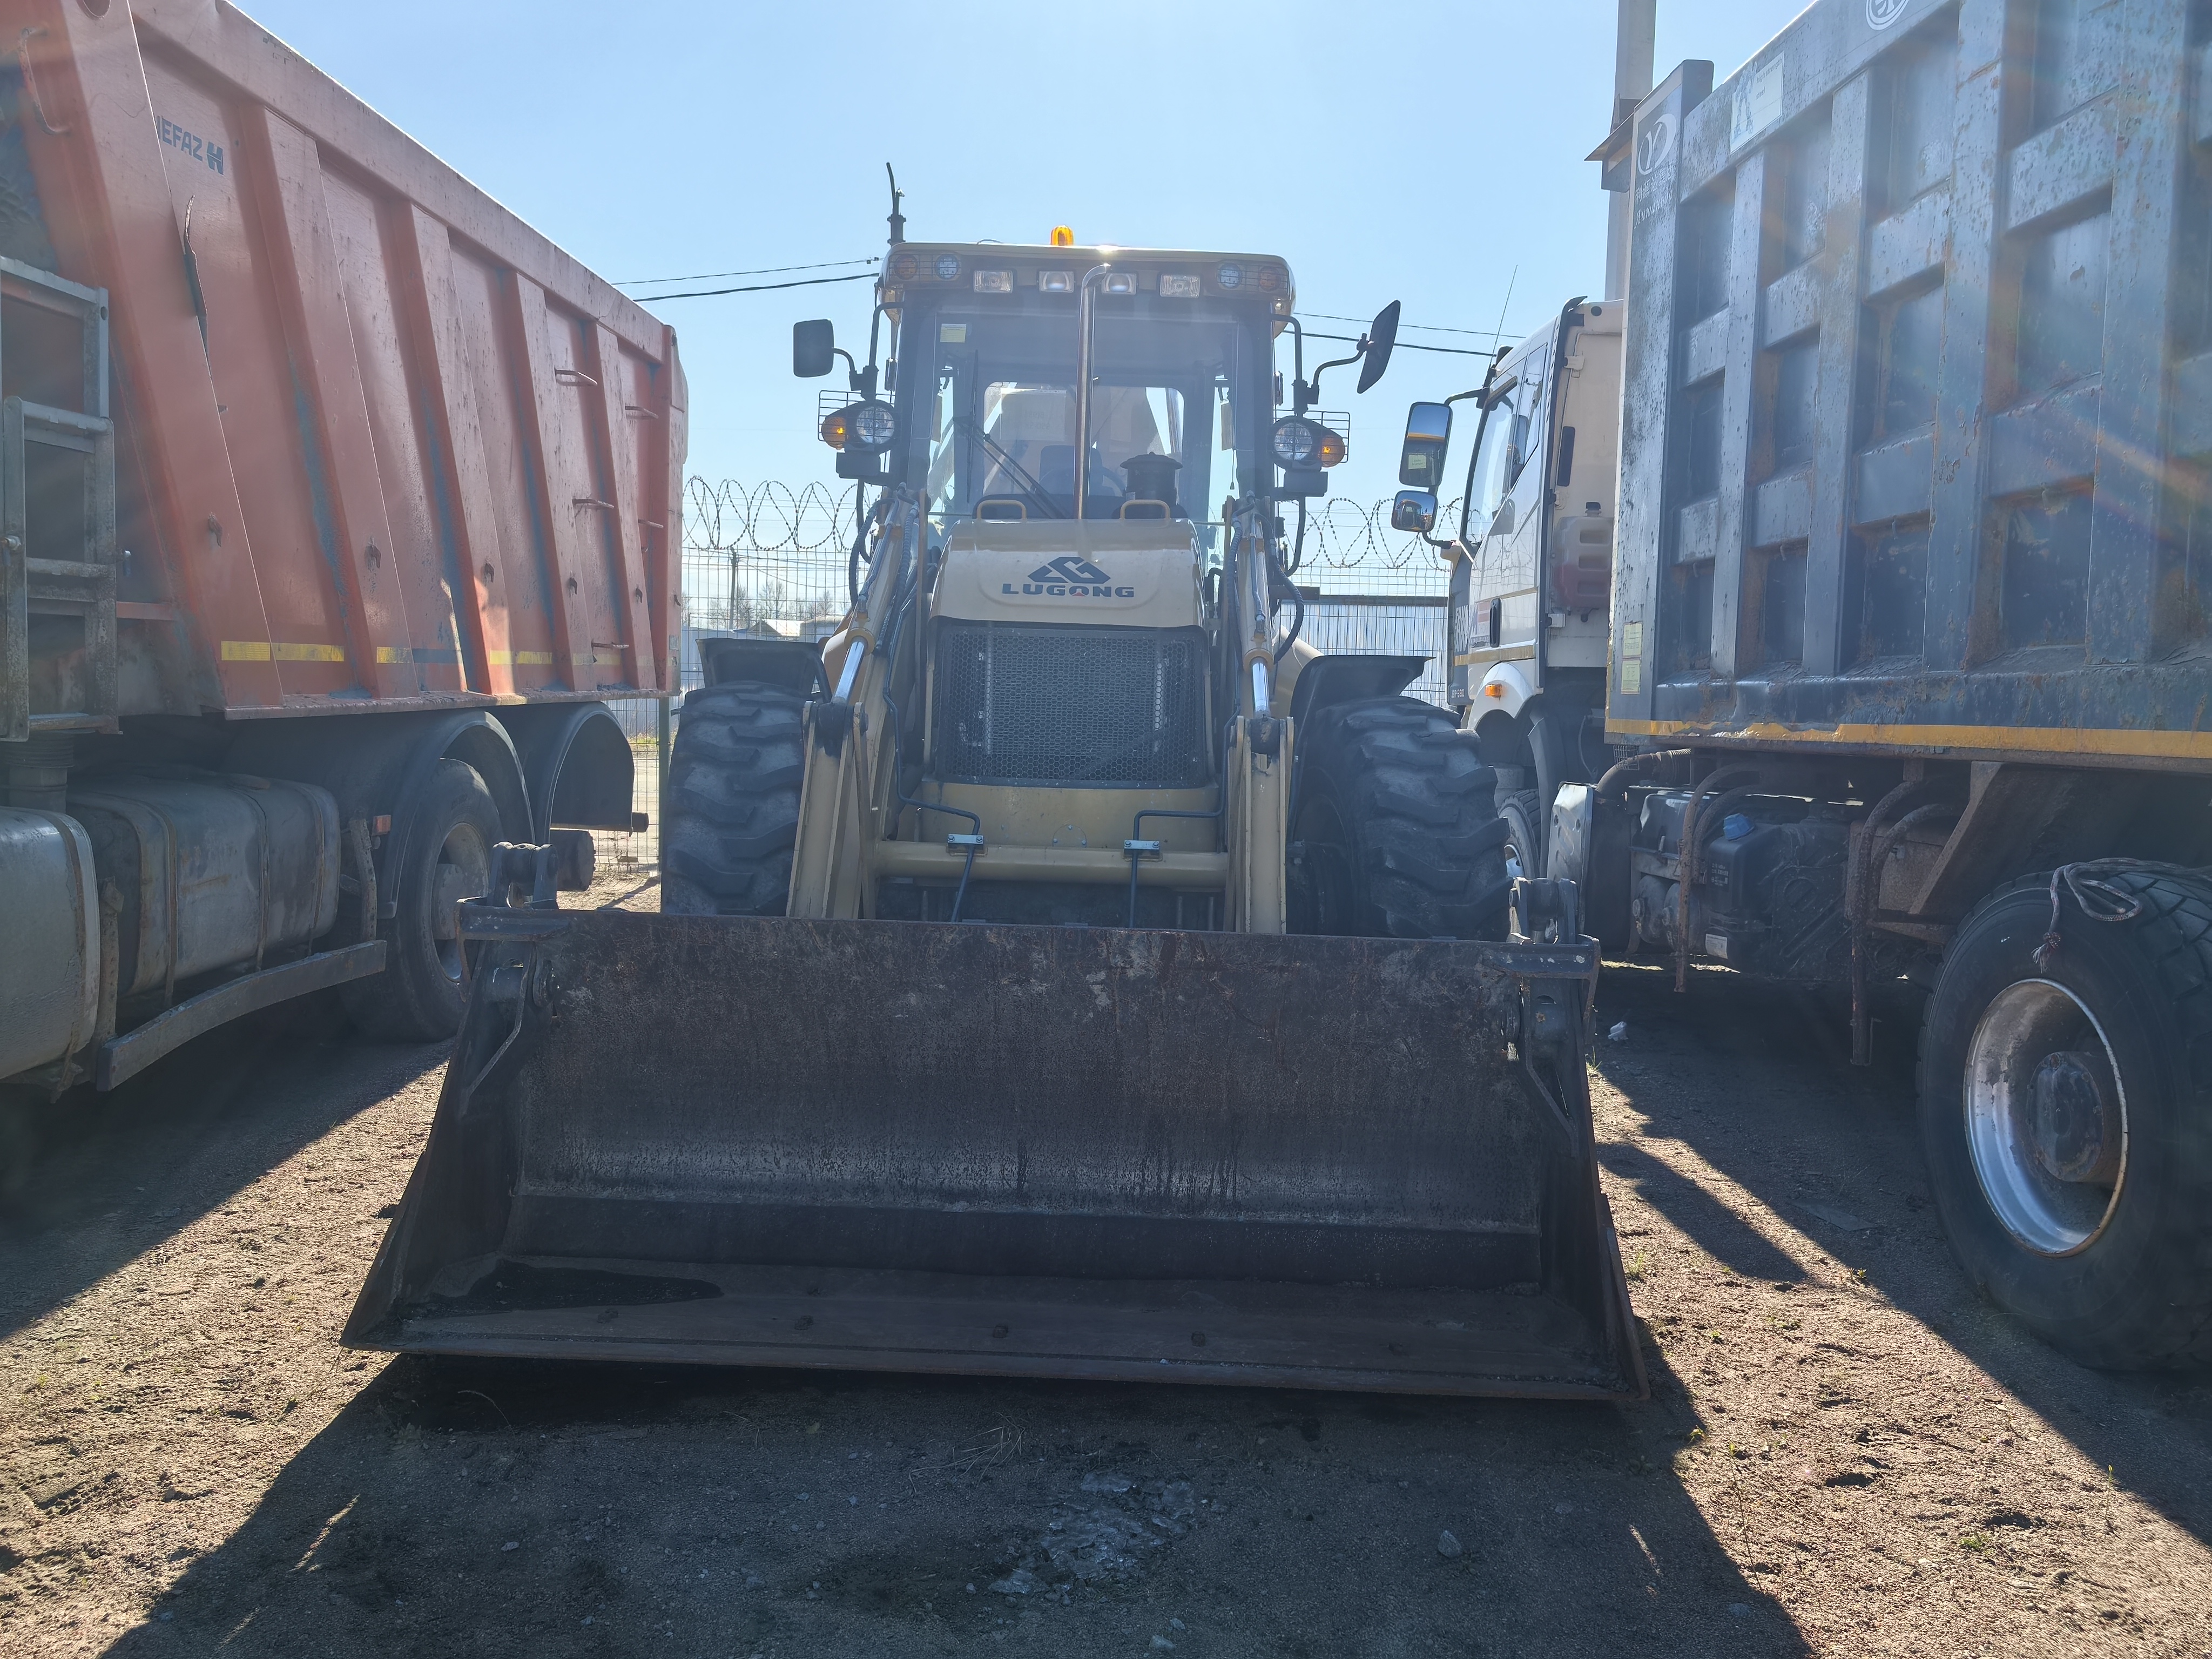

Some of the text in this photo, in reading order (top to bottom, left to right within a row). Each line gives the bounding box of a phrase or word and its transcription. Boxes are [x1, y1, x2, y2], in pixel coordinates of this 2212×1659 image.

[1766, 57, 1783, 76] strength
[1756, 86, 1765, 100] steel
[1002, 583, 1134, 598] LUGONG
